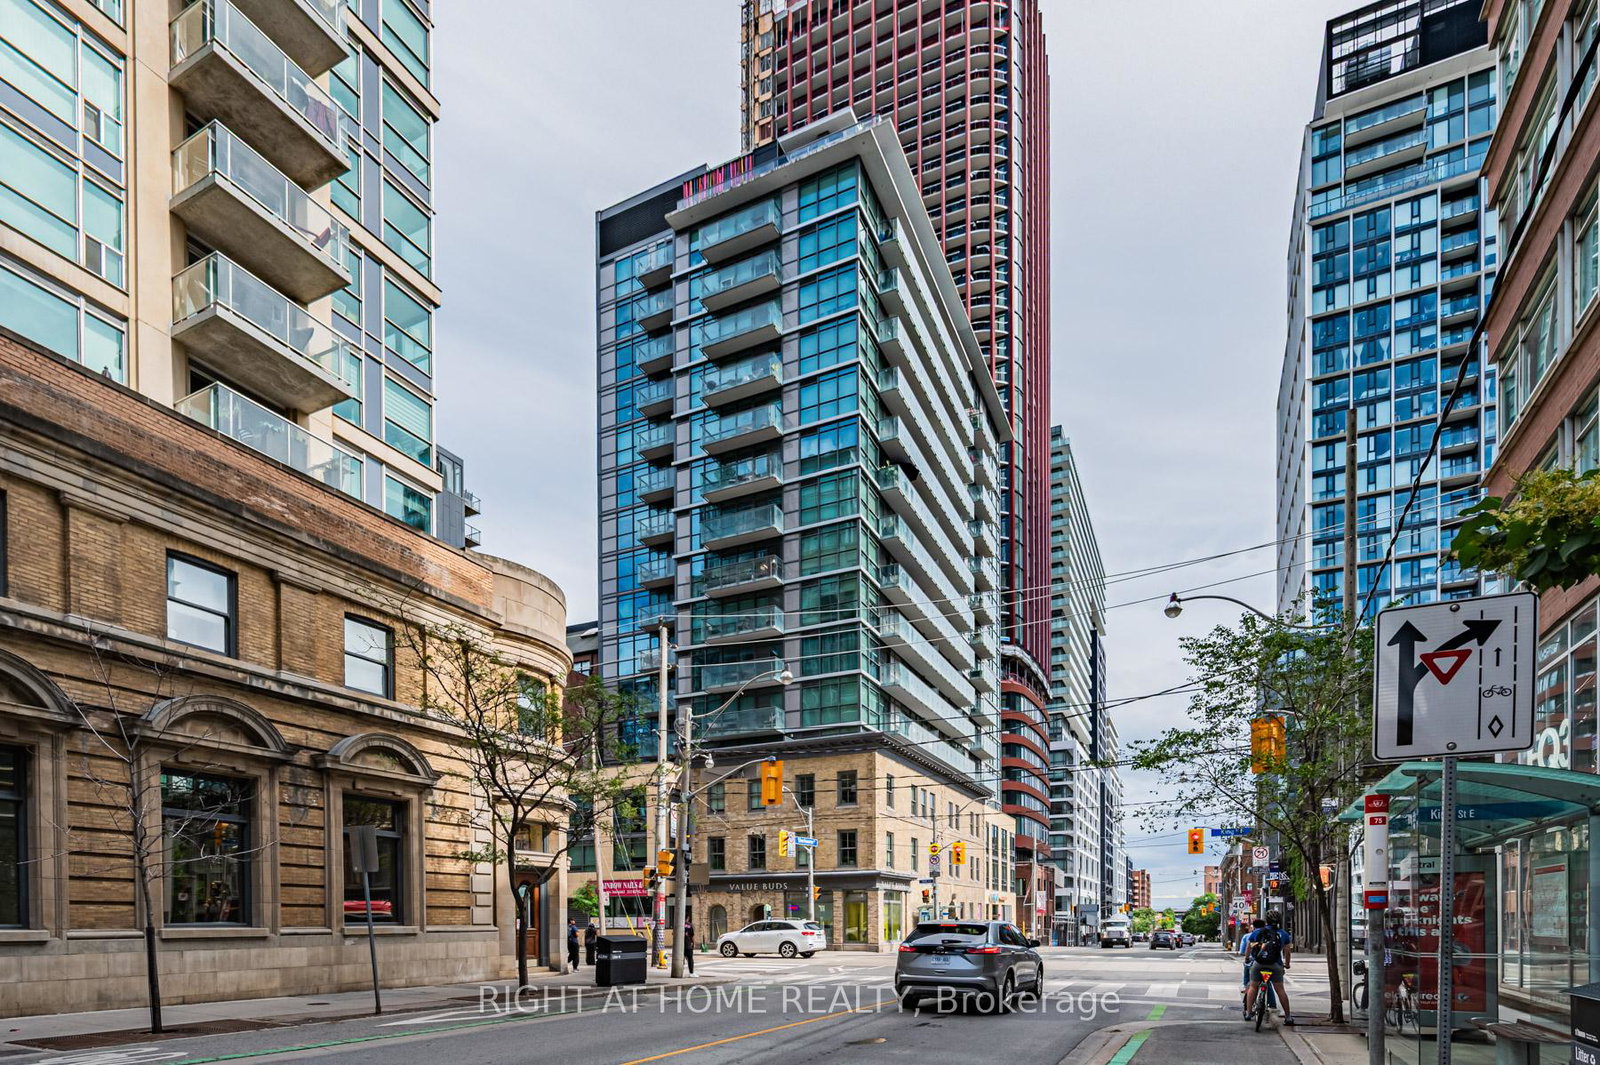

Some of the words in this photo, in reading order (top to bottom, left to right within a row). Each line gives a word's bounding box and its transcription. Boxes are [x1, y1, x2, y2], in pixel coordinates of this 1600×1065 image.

[1457, 810, 1467, 819] St
[1469, 809, 1475, 818] E
[729, 883, 759, 891] VALUE
[762, 882, 788, 890] BUDS
[1575, 1046, 1590, 1064] Litter
